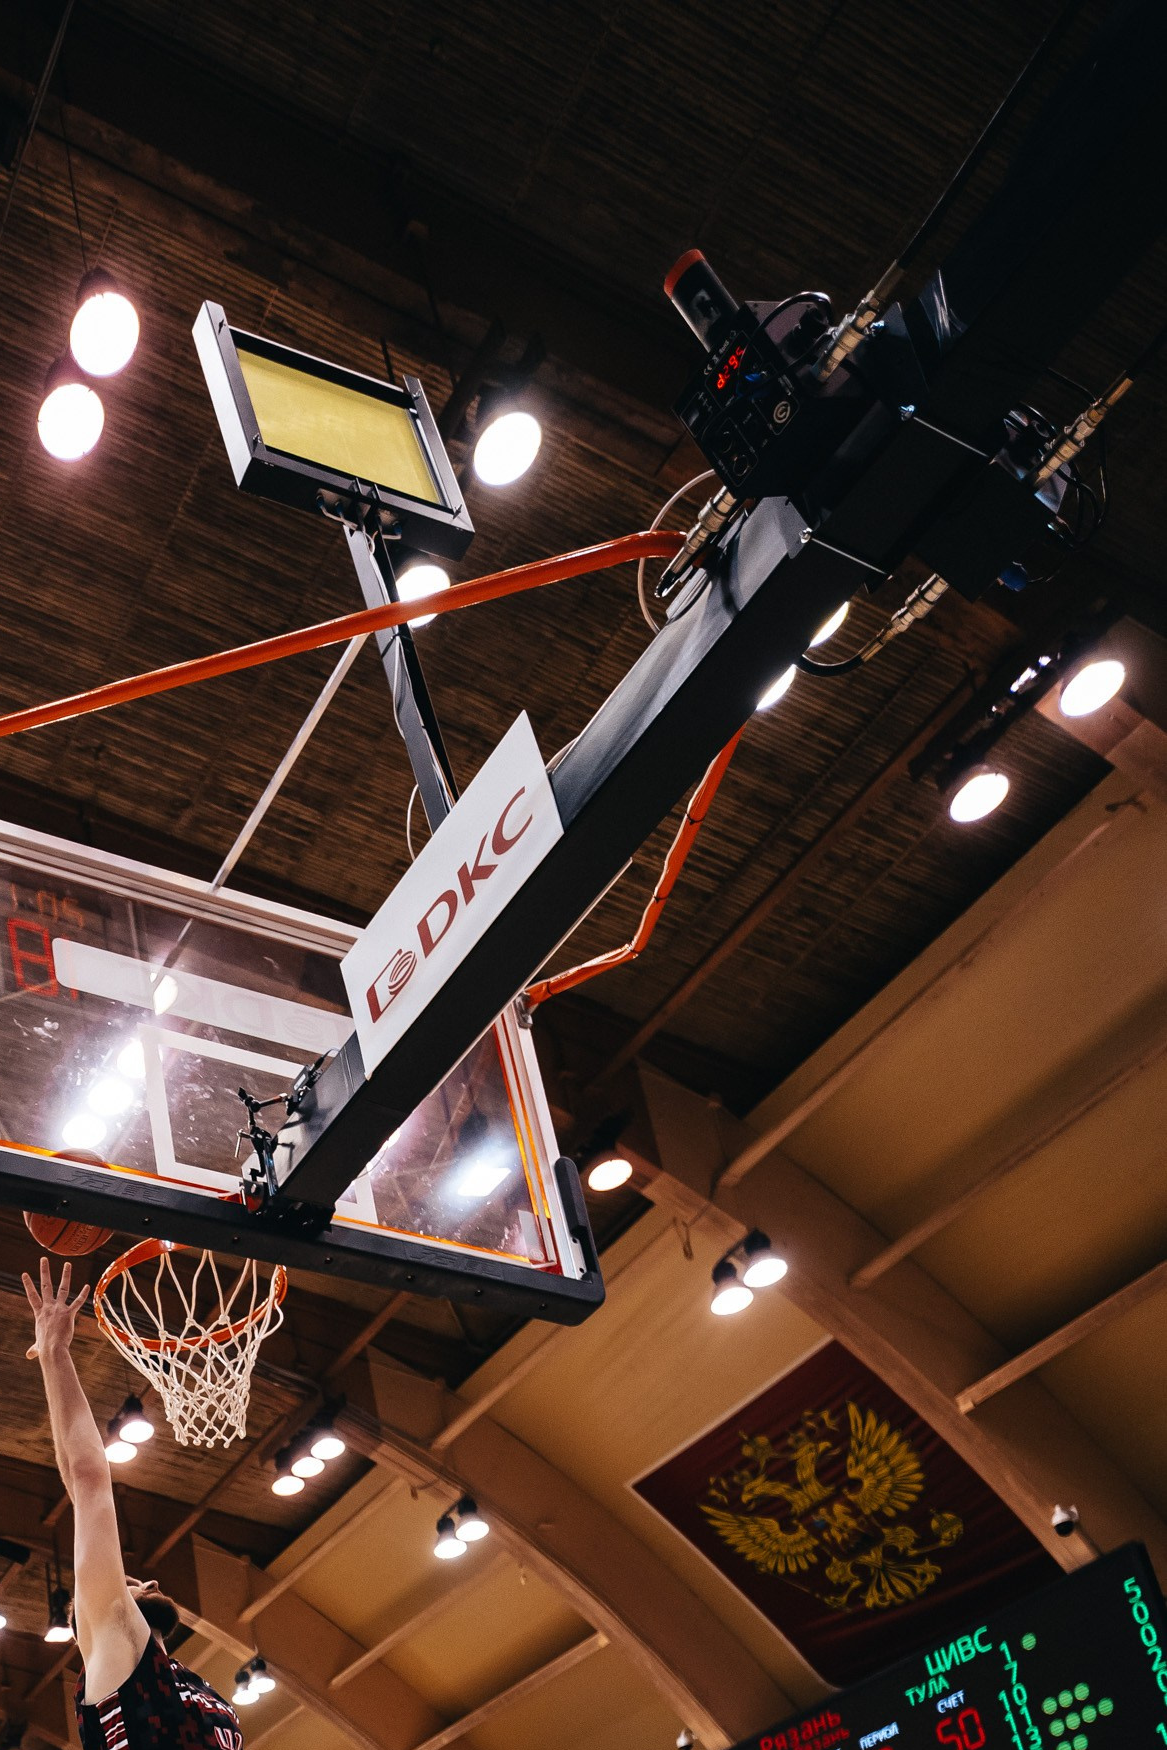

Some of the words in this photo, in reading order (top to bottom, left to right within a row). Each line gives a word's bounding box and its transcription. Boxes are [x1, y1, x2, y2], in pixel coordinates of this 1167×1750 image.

[416, 785, 533, 960] DKC
[1123, 1576, 1142, 1604] 5
[924, 1625, 993, 1677] ЦИВС
[905, 1674, 950, 1706] ТУЛА
[936, 1689, 965, 1713] СЧЕТ
[858, 1721, 900, 1750] ПЕРИОД
